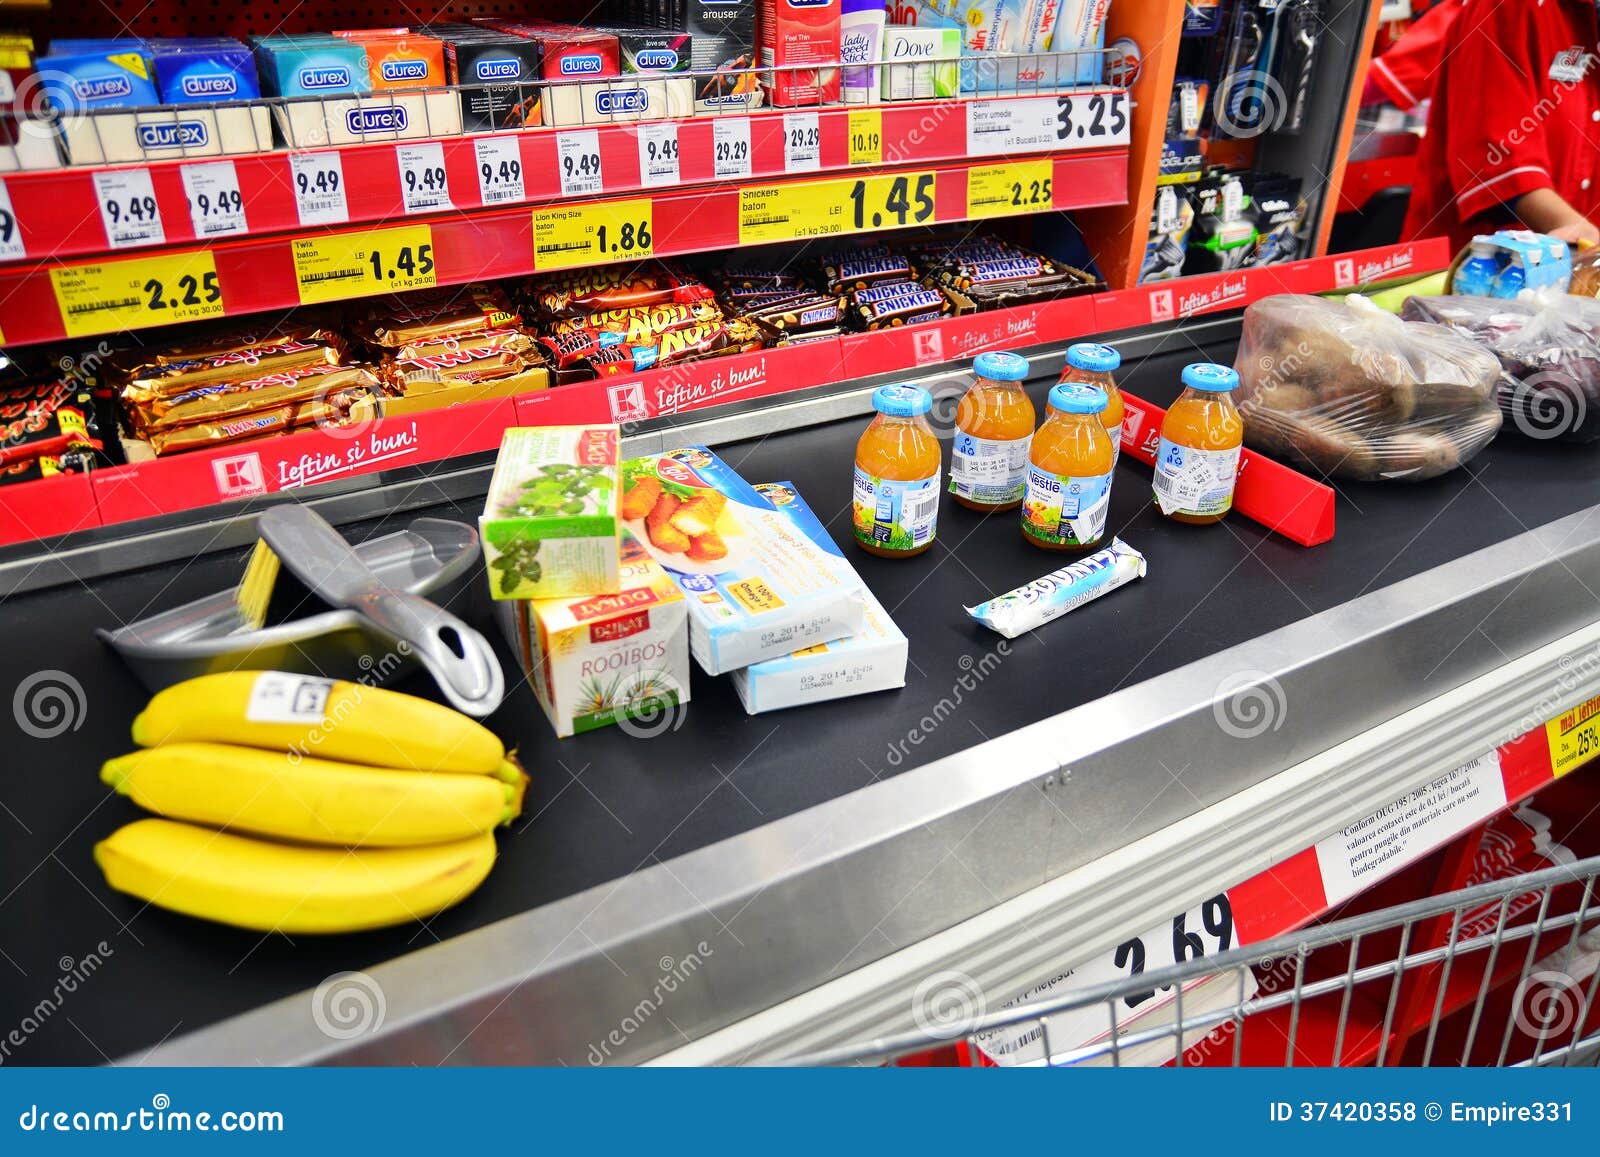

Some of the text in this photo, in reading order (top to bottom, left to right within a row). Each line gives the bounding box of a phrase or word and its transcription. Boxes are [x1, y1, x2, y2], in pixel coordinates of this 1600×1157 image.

[702, 9, 738, 20] arouser
[845, 33, 865, 47] lady
[894, 37, 934, 57] Dove
[386, 61, 426, 79] durex
[480, 62, 518, 77] durex
[564, 56, 600, 73] durex
[639, 51, 677, 68] durex
[76, 75, 130, 97] durex
[185, 76, 235, 95] durex
[302, 67, 348, 87] durex
[599, 90, 648, 113] durex
[349, 107, 405, 130] durex
[1057, 94, 1126, 140] 3.25
[142, 121, 204, 146] durex
[791, 127, 819, 147] 29.29
[852, 133, 879, 152] 10.19
[647, 139, 678, 161] 9.49
[716, 140, 747, 162] 29.29
[482, 160, 520, 185] 9.49
[563, 153, 600, 178] 9.49
[297, 169, 339, 195] 9.49
[405, 167, 446, 192] 9.49
[743, 187, 779, 199] Snickers
[850, 174, 934, 229] 1.45
[1011, 178, 1052, 206] 2.25
[107, 196, 157, 223] 9.49
[198, 190, 242, 217] 9.49
[743, 202, 766, 212] baton
[829, 206, 842, 216] LEI
[535, 211, 582, 222] Lion King Size
[536, 223, 555, 231] baton
[296, 241, 313, 249] Twix
[597, 221, 651, 253] 1.86
[296, 251, 319, 259] baton
[354, 252, 365, 260] LEI
[370, 244, 434, 281] 1.45
[980, 257, 1040, 274] SNICKERS
[843, 256, 909, 277] SNICKERS
[144, 271, 221, 311] 2.25
[391, 276, 435, 289] (=1 kg 29.00)
[1222, 275, 1247, 298] bun!
[189, 308, 199, 317] kg
[201, 305, 224, 315] 30.00)
[876, 291, 941, 315] SNICKERS
[491, 311, 513, 322] 100
[803, 307, 837, 324] SNICKERS
[1007, 311, 1037, 334] bun!
[656, 357, 767, 414] Ieftin bun!
[223, 416, 277, 437] Twix Xtra
[279, 421, 419, 489] Ieftin bun!
[1017, 549, 1118, 605] BOUNTY
[579, 589, 651, 615] DUKAT
[1063, 585, 1102, 610] BOUNTY
[761, 632, 774, 641] 09
[781, 623, 806, 637] 2014
[580, 640, 667, 678] ROOIBOS
[800, 675, 814, 684] 09
[820, 669, 847, 682] 2014
[1577, 725, 1599, 757] 25%
[1339, 816, 1376, 839] "Conform
[1376, 803, 1395, 825] OUG
[1394, 796, 1408, 814] 195
[1411, 785, 1428, 802] 2005
[1432, 777, 1449, 796] legea
[1449, 768, 1460, 783] 167
[1346, 830, 1376, 851] valoarea
[1377, 817, 1405, 837] ecotaxei
[1405, 812, 1418, 826] este
[1419, 806, 1427, 820] de
[1437, 794, 1446, 807] lei
[1349, 786, 1480, 867] pentru pungile din materiale care nu sunt
[1351, 840, 1408, 878] biodegradabile."
